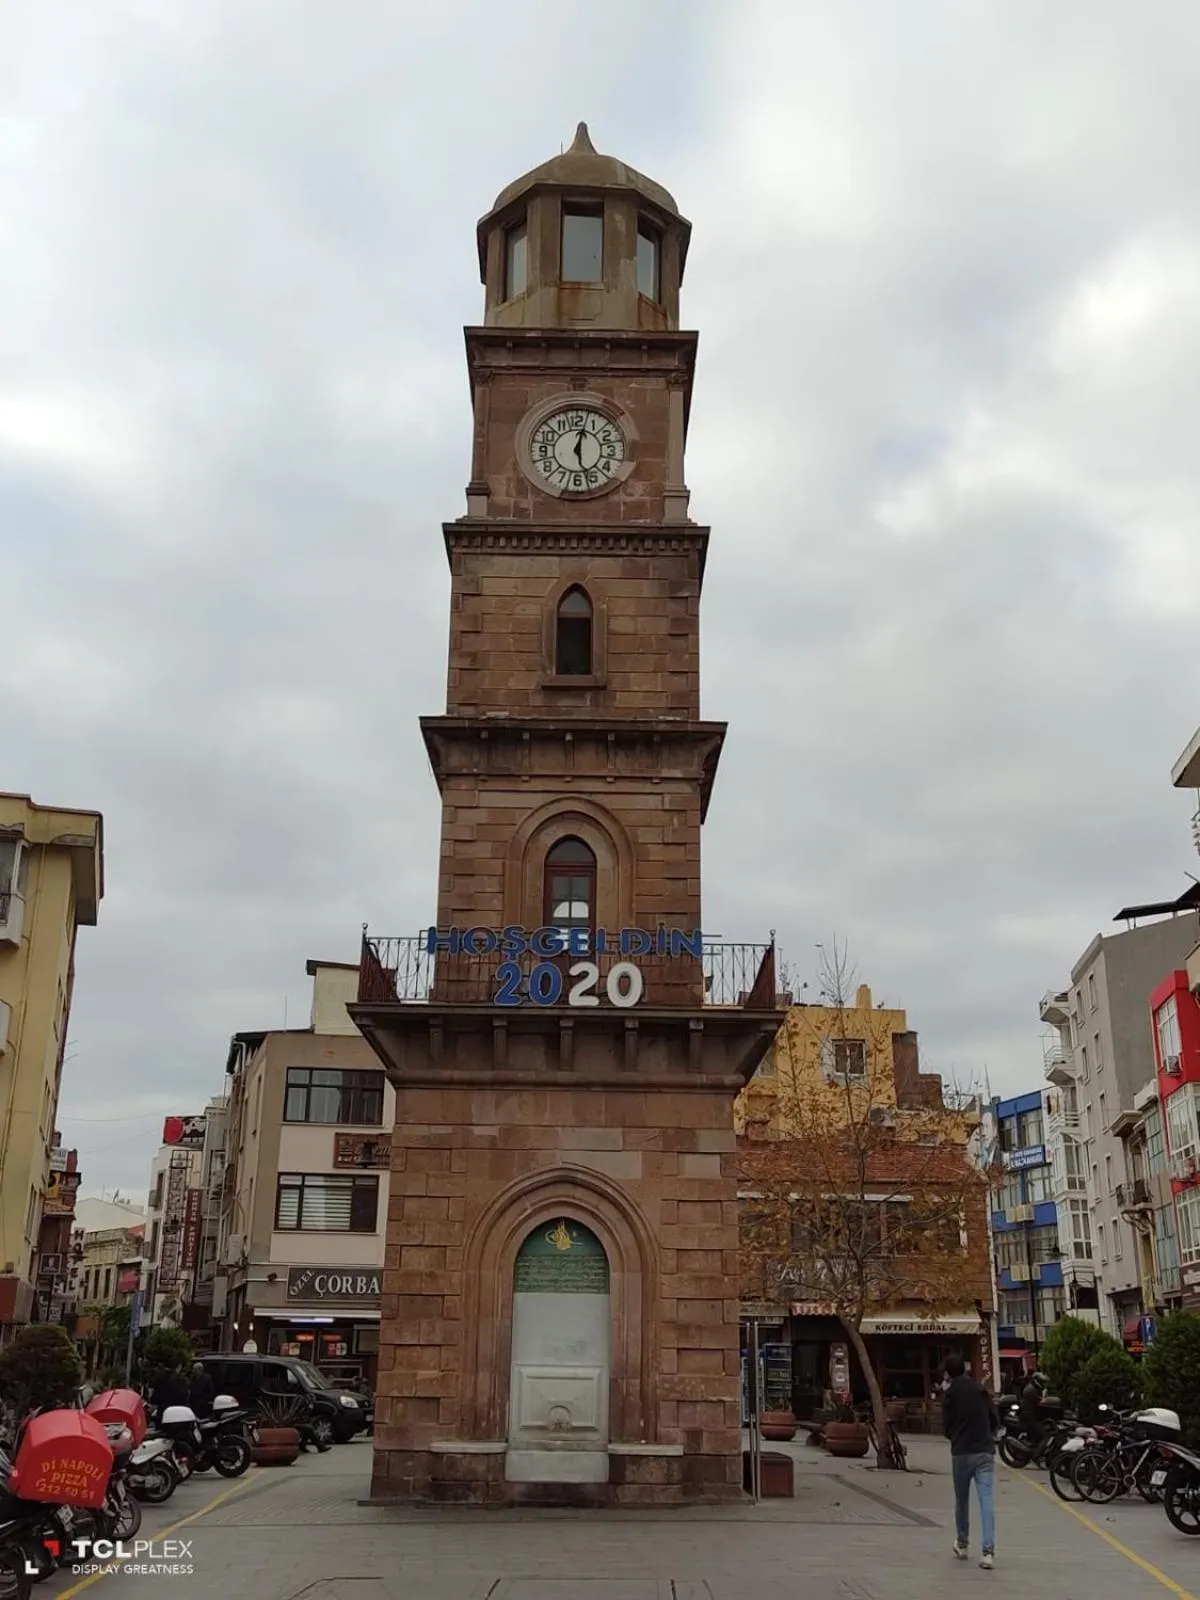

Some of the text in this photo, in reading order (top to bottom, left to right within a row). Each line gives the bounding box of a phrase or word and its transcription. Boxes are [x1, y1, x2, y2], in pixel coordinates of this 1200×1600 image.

[557, 419, 566, 431] 11
[570, 415, 583, 427] 12
[590, 420, 597, 431] 1
[541, 430, 555, 442] 10
[602, 429, 612, 441] 2
[538, 445, 548, 457] 9
[606, 445, 616, 457] 3
[543, 460, 552, 473] 8
[602, 460, 611, 472] 4
[558, 471, 566, 483] 7
[573, 474, 582, 487] 6
[588, 470, 598, 482] 5
[428, 923, 703, 961] HOŞGELDİN
[494, 962, 643, 1007] 2020
[314, 1274, 381, 1297] ÇORBA
